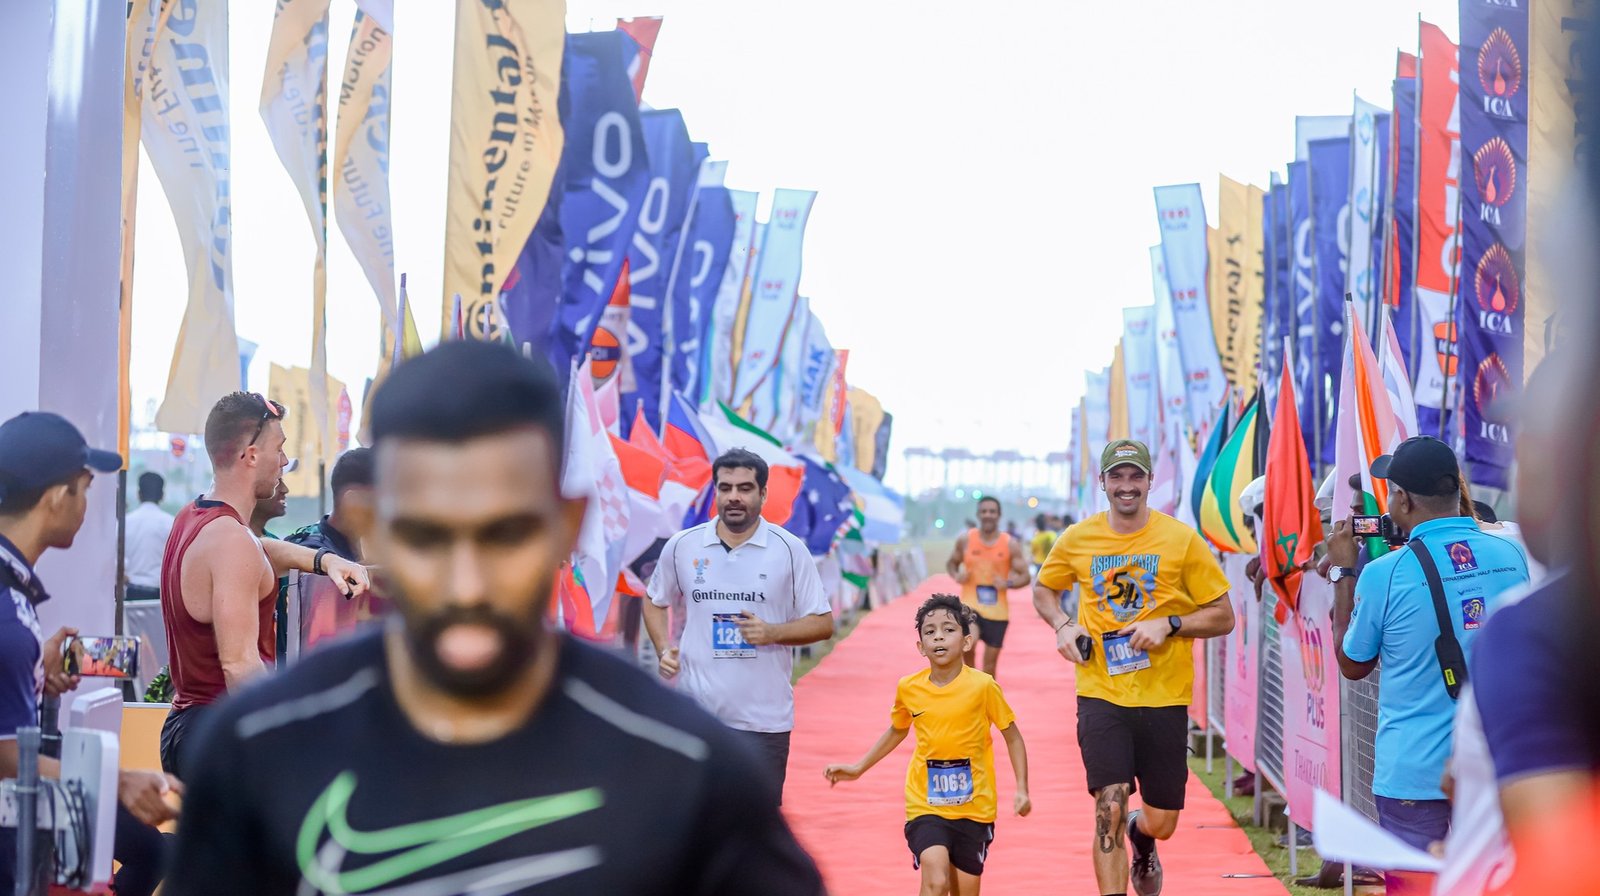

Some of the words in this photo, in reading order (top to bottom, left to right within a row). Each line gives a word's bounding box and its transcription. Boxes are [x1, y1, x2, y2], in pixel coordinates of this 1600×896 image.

[1483, 95, 1514, 118] ICA
[1480, 202, 1502, 226] ICA
[1479, 310, 1514, 335] ICA
[1480, 421, 1510, 444] ICA
[1090, 554, 1129, 578] ASBURY
[1131, 553, 1160, 577] PARK
[1458, 562, 1473, 571] ICA
[1477, 569, 1491, 577] HALF
[692, 589, 756, 603] Continental
[1307, 692, 1325, 730] PLUS
[933, 772, 968, 793] 1063
